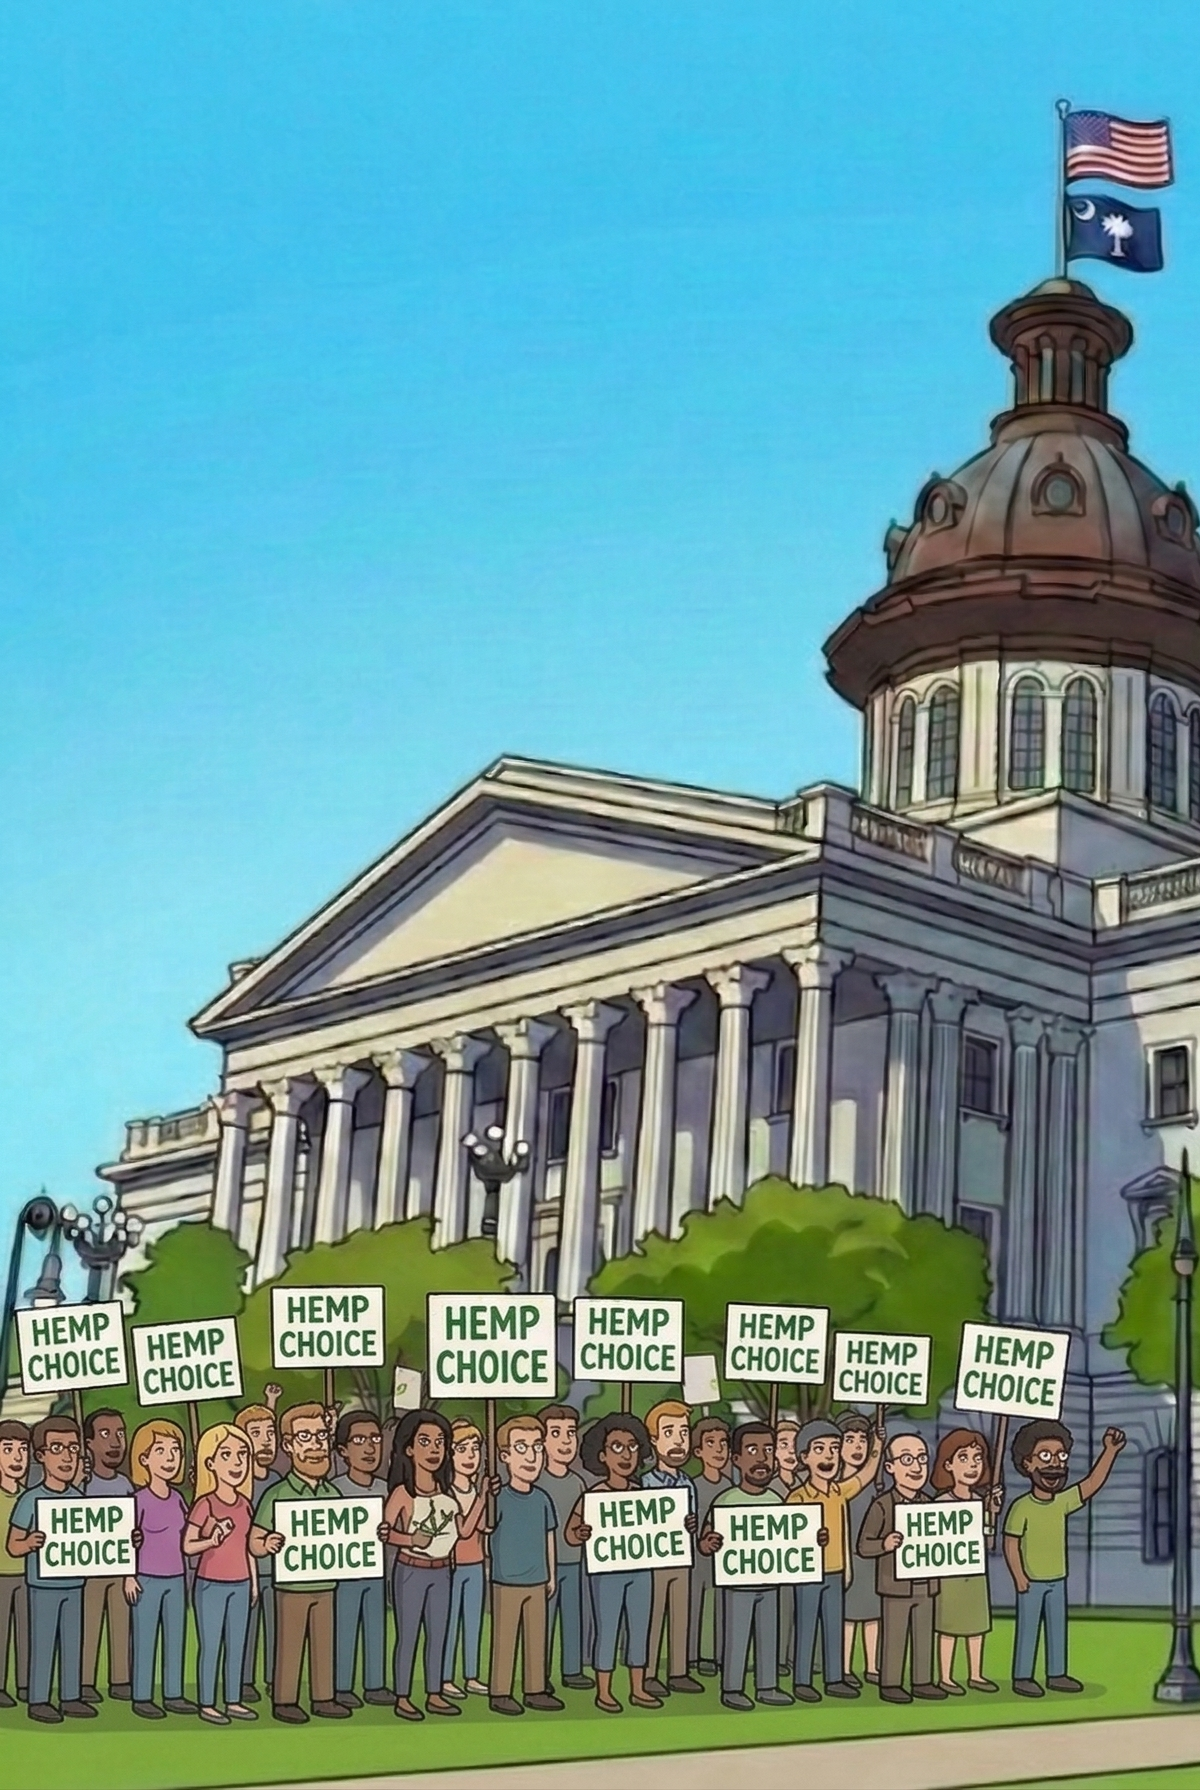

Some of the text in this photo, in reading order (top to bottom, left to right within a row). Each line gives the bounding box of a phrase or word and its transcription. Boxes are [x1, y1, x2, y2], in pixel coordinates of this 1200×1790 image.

[288, 1295, 369, 1323] HEMP
[446, 1305, 539, 1340] HEMP
[590, 1308, 669, 1336] HEMP
[32, 1313, 109, 1346] HEMP
[740, 1314, 814, 1341] HEMP
[147, 1328, 224, 1361] HEMP
[280, 1330, 376, 1357] CHOICE
[581, 1343, 675, 1371] CHOICE
[847, 1341, 917, 1366] HEMP
[975, 1335, 1054, 1369] HEMP
[28, 1347, 120, 1381] CHOICE
[437, 1350, 548, 1384] CHOICE
[731, 1346, 819, 1373] CHOICE
[144, 1361, 234, 1394] CHOICE
[839, 1370, 922, 1396] CHOICE
[964, 1370, 1056, 1406] CHOICE
[52, 1506, 123, 1534] HEMP
[292, 1506, 368, 1537] HEMP
[600, 1497, 675, 1528] HEMP
[731, 1513, 808, 1541] HEMP
[907, 1510, 973, 1537] HEMP
[43, 1537, 130, 1567] CHOICE
[282, 1539, 376, 1571] CHOICE
[594, 1531, 684, 1562] CHOICE
[723, 1547, 815, 1575] CHOICE
[899, 1539, 980, 1568] CHOICE
